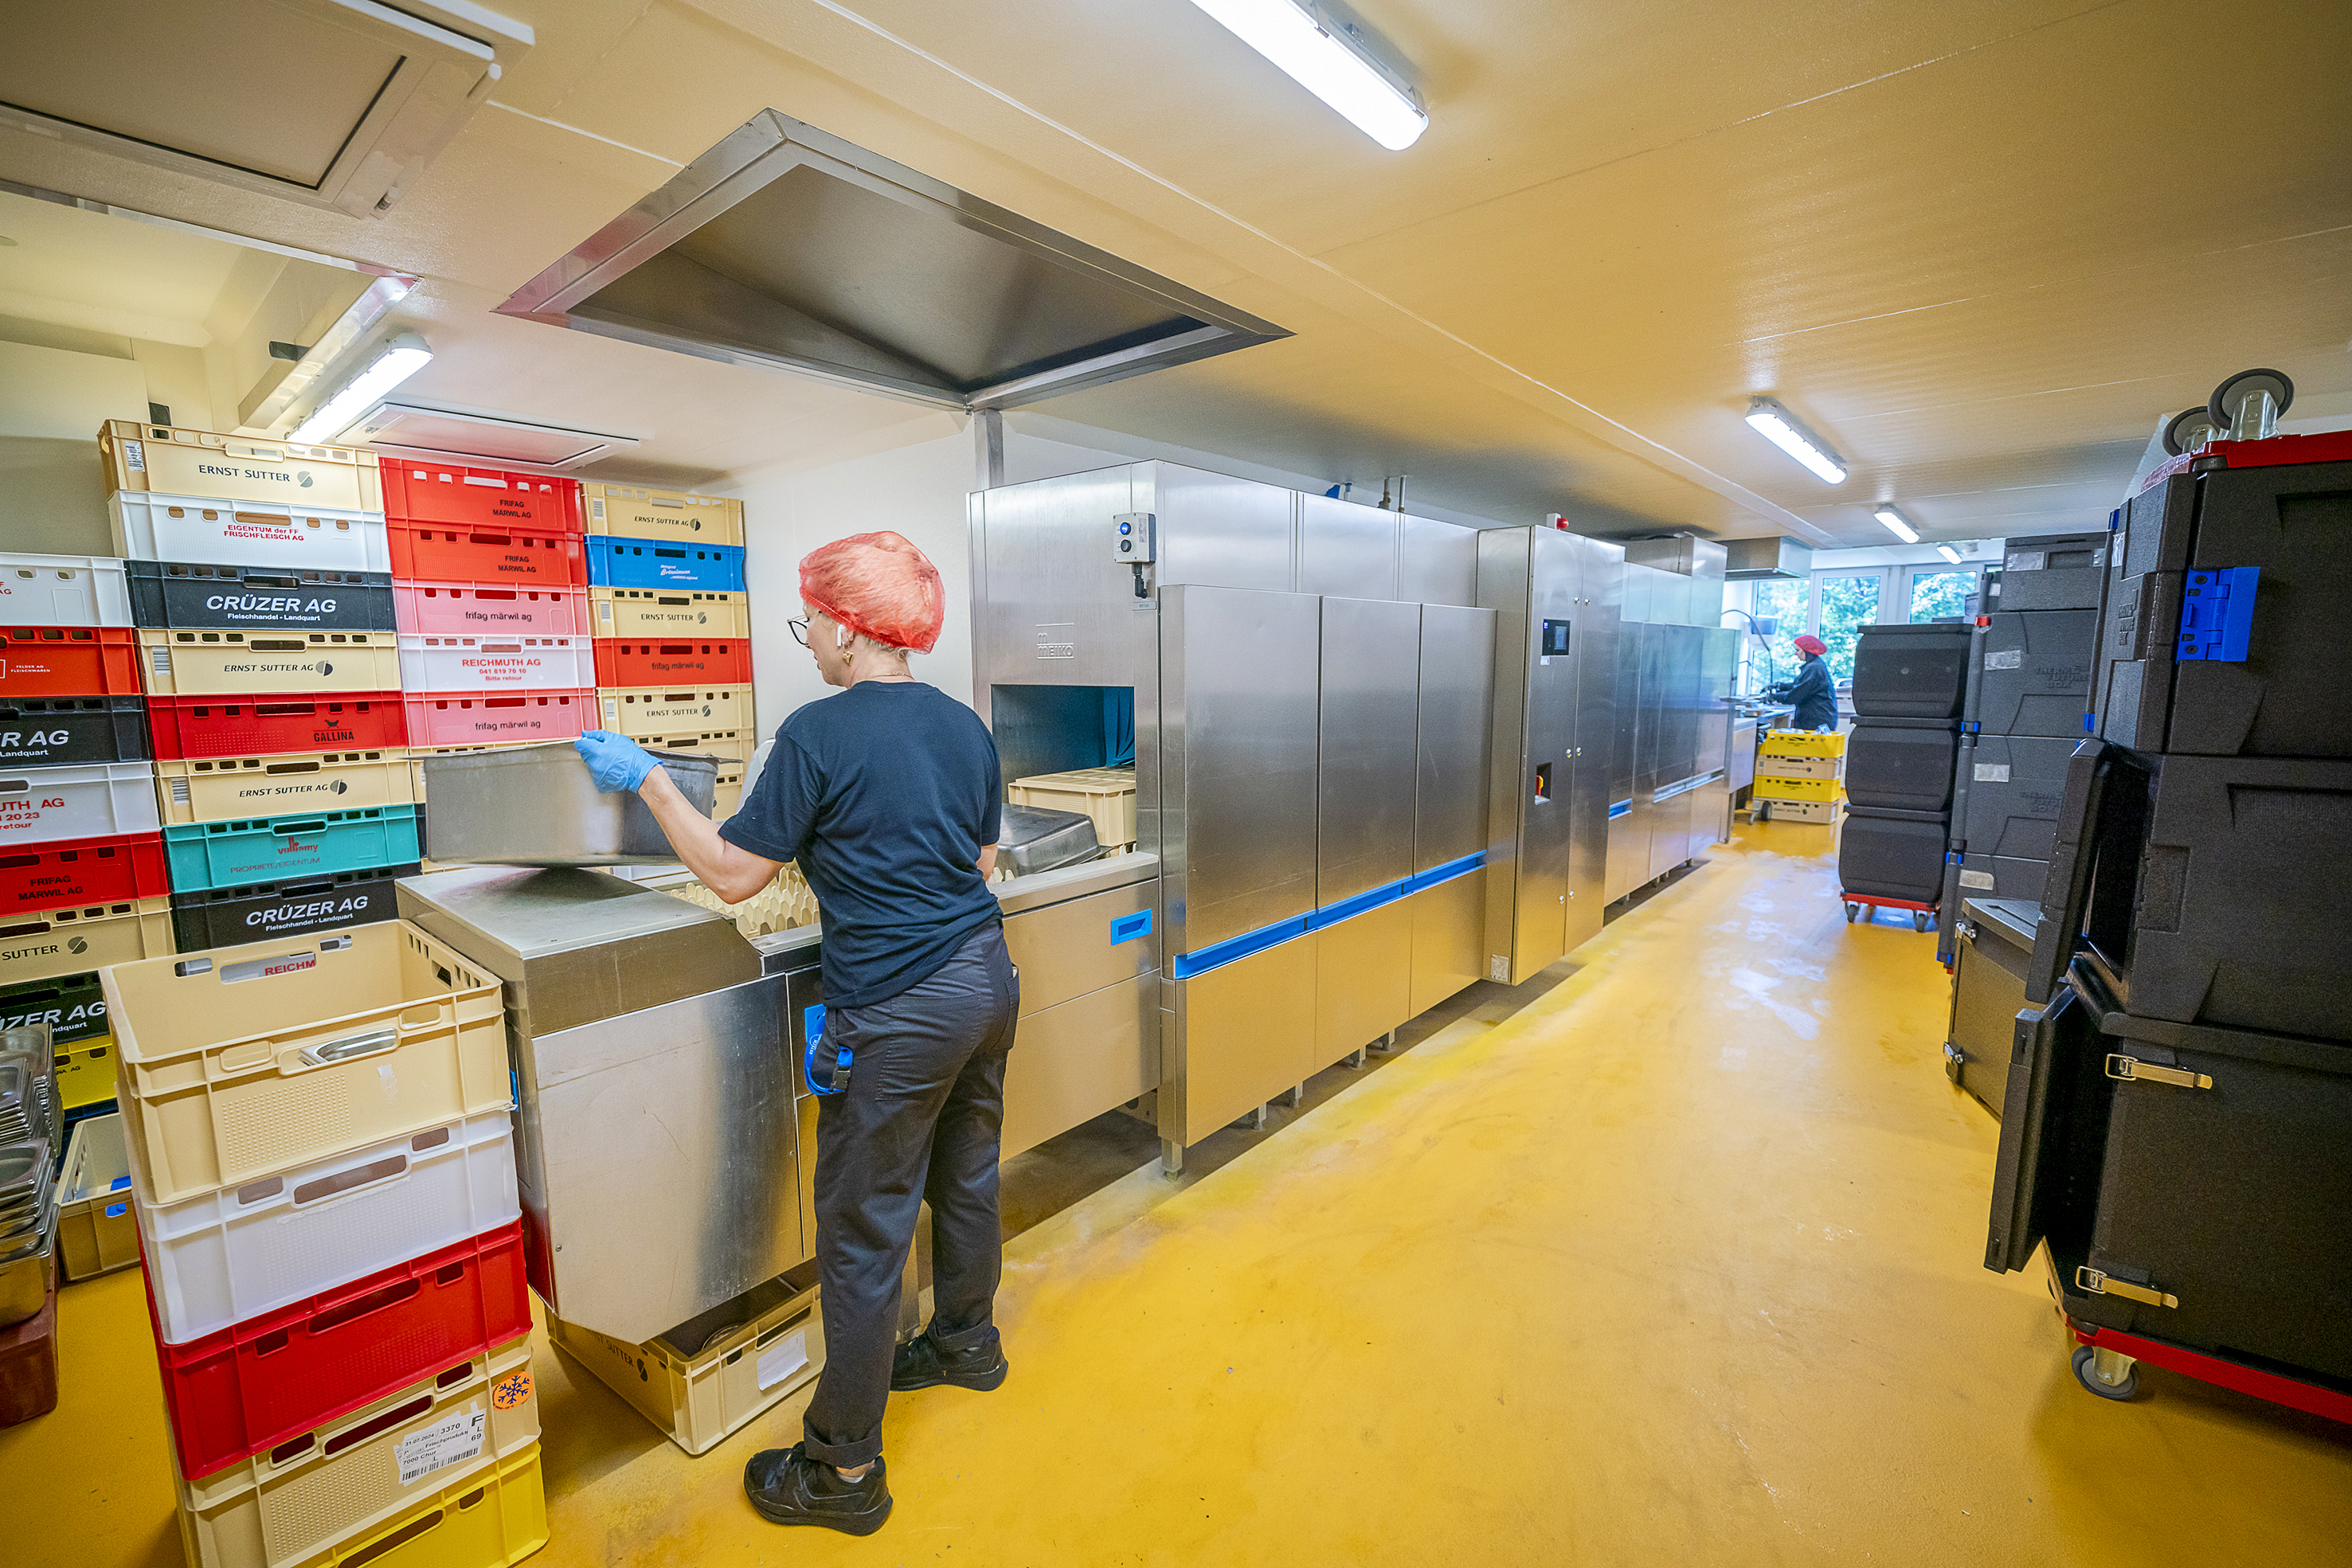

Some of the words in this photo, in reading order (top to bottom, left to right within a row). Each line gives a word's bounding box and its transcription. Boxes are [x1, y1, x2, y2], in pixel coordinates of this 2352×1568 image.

[198, 464, 240, 477] ERNST
[245, 469, 291, 482] SUTTER
[499, 499, 525, 508] FRIFAG
[224, 530, 291, 541] FRISCHFLEISCH
[227, 524, 272, 533] EIGENTUM
[206, 593, 301, 612] CRÜZER
[304, 598, 337, 613] AG
[465, 611, 488, 621] frifag
[652, 663, 670, 671] frifag
[475, 722, 498, 732] frifag
[499, 721, 528, 729] märwil
[26, 729, 69, 747] AG
[314, 731, 354, 742] GALLINA
[239, 788, 273, 797] ERNST
[275, 785, 313, 795] SUTTER
[41, 798, 65, 808] AG
[277, 835, 319, 855] vulliamy
[29, 875, 71, 886] FRIFAG
[18, 889, 65, 901] MÄRWIL
[67, 886, 84, 894] AG
[245, 901, 335, 926] CRÜZER
[338, 895, 369, 913] AG
[265, 918, 314, 931] Fleischhandel
[319, 913, 354, 924] Landquart
[2, 944, 60, 961] SUTTER
[264, 959, 315, 976] REICHM
[67, 1001, 107, 1021] AG
[605, 1339, 634, 1367] SUTTER
[472, 1414, 485, 1427] F
[405, 1433, 435, 1447] 31.07.2024
[440, 1423, 461, 1434] 3370
[403, 1456, 419, 1465] 7000
[420, 1450, 437, 1459] Chur
